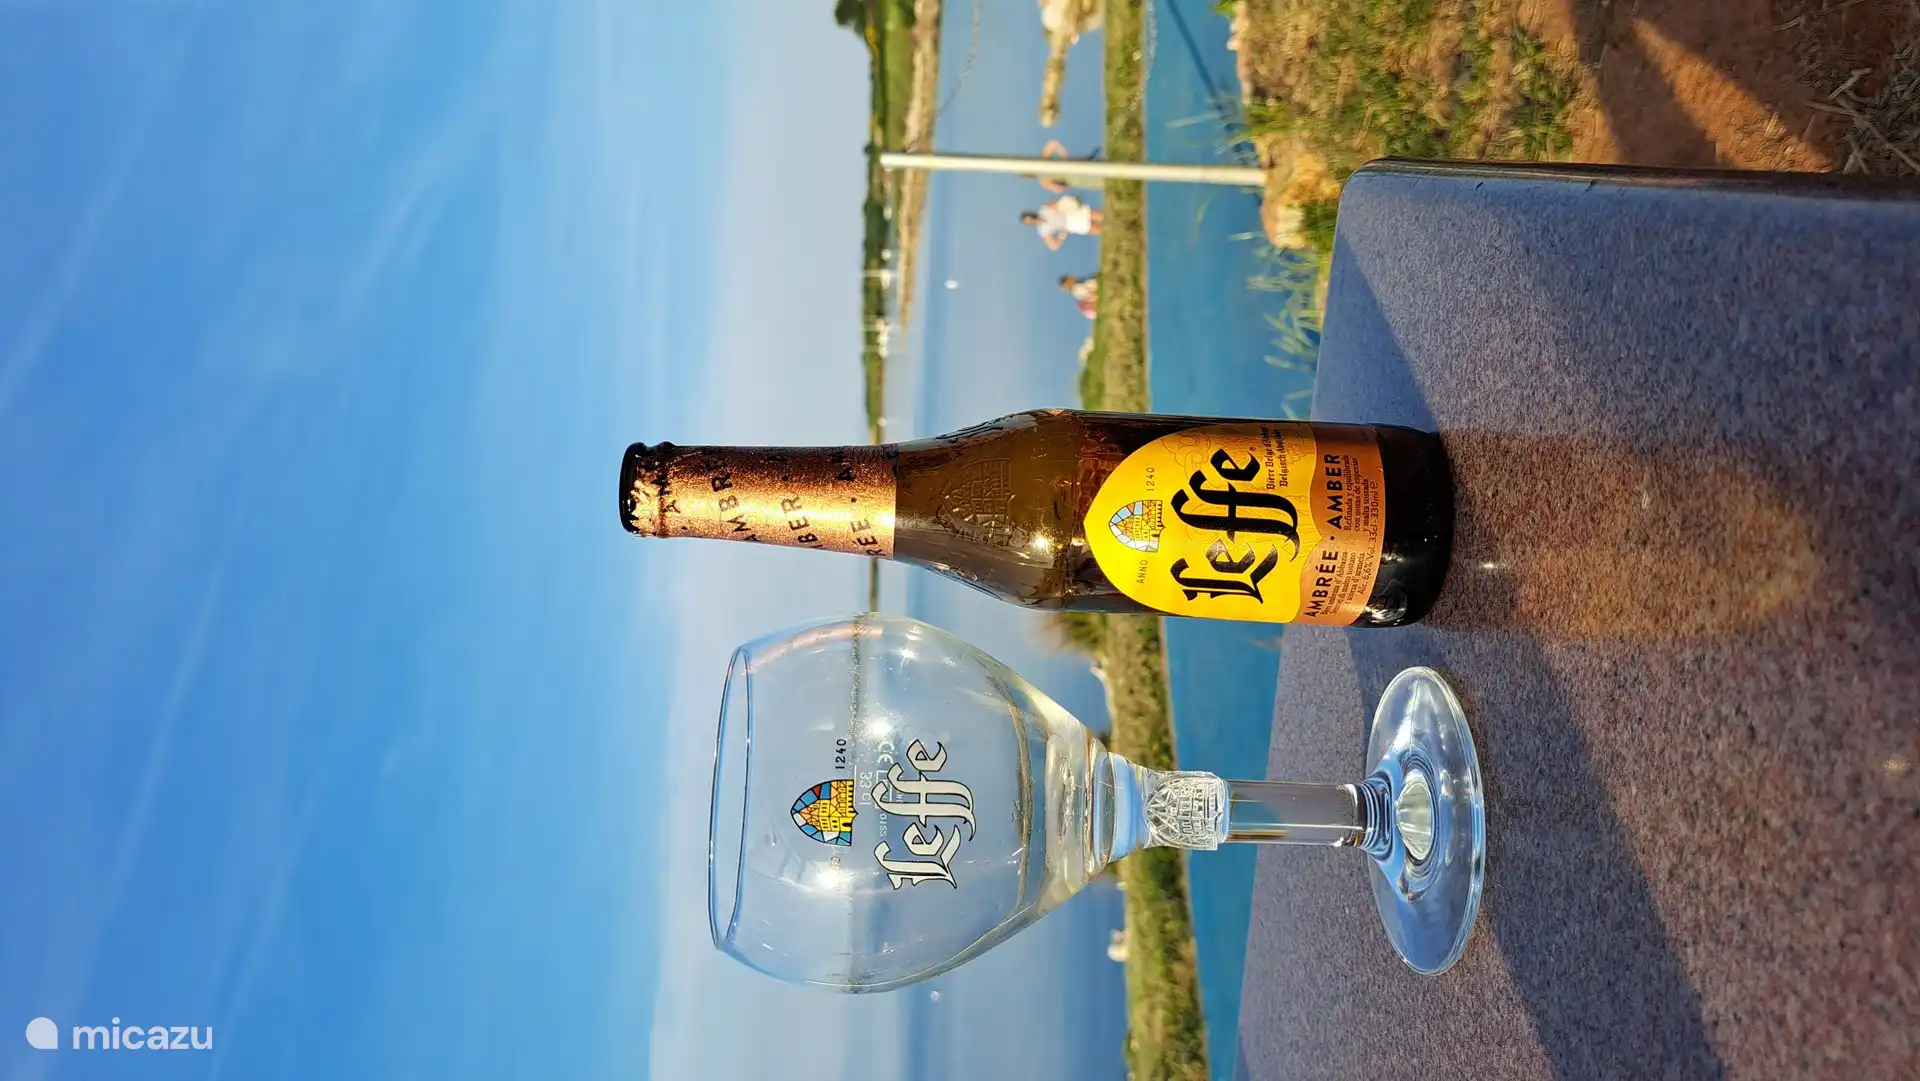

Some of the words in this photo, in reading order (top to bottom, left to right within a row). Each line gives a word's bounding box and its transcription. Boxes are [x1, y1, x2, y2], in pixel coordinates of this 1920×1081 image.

[1264, 448, 1274, 468] Belge
[1278, 454, 1289, 487] Belgisch
[1342, 455, 1354, 490] equilibrada
[1351, 458, 1362, 484] especias
[1146, 468, 1155, 492] 1240
[1324, 454, 1342, 530] AMBER
[1353, 486, 1360, 494] de
[711, 473, 757, 540] AMBR
[1344, 499, 1352, 530] Refinada
[1170, 448, 1300, 604] Leffe
[1366, 545, 1376, 559] Vol.
[1136, 560, 1148, 584] ANNO
[1303, 550, 1338, 617] AMBRÉE
[1341, 576, 1351, 592] malto
[1346, 552, 1356, 574] tostato
[1362, 562, 1372, 580] 6,6%
[1357, 582, 1368, 594] Alc.
[835, 738, 846, 770] 1240
[870, 739, 976, 890] Leffe
